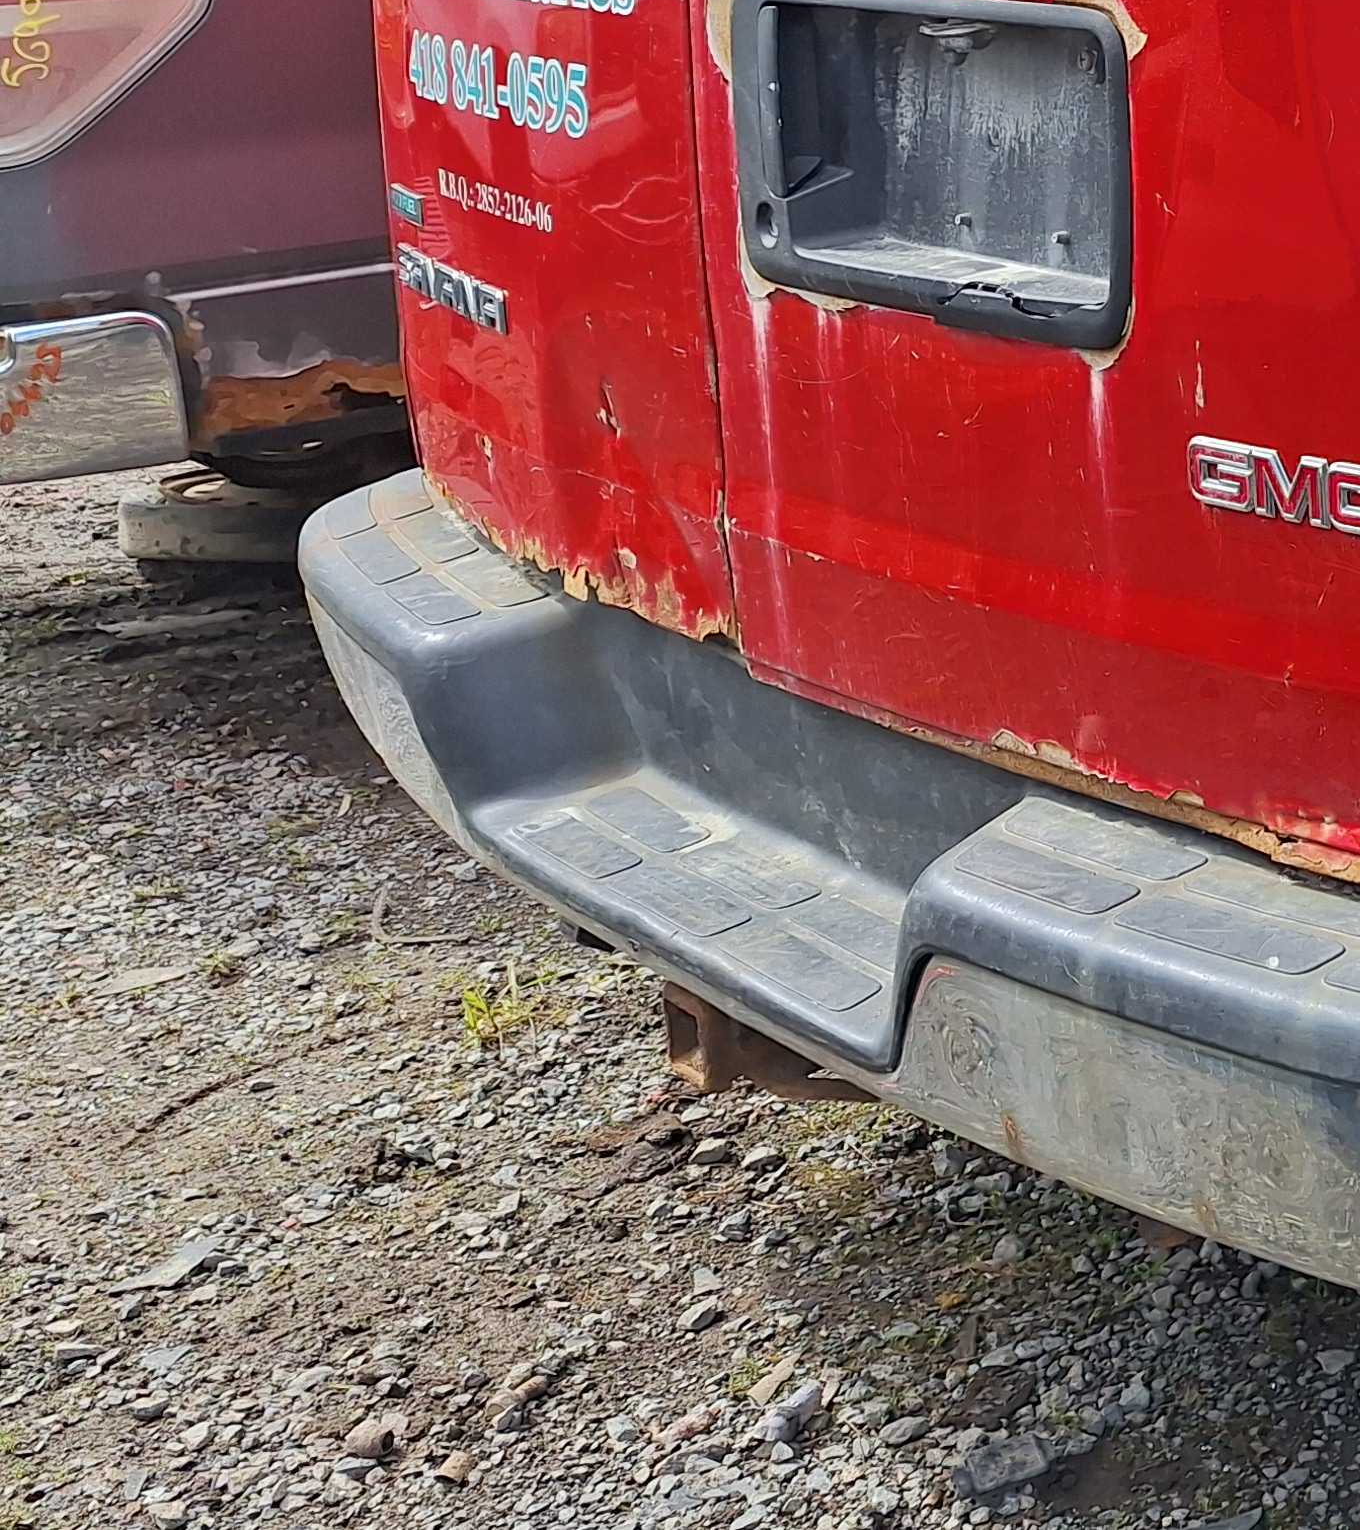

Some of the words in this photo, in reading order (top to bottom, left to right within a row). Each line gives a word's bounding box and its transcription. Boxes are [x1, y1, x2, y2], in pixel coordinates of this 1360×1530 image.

[409, 28, 449, 106] 418
[449, 39, 589, 138] 841-0595
[475, 181, 553, 233] 2852-2126-06
